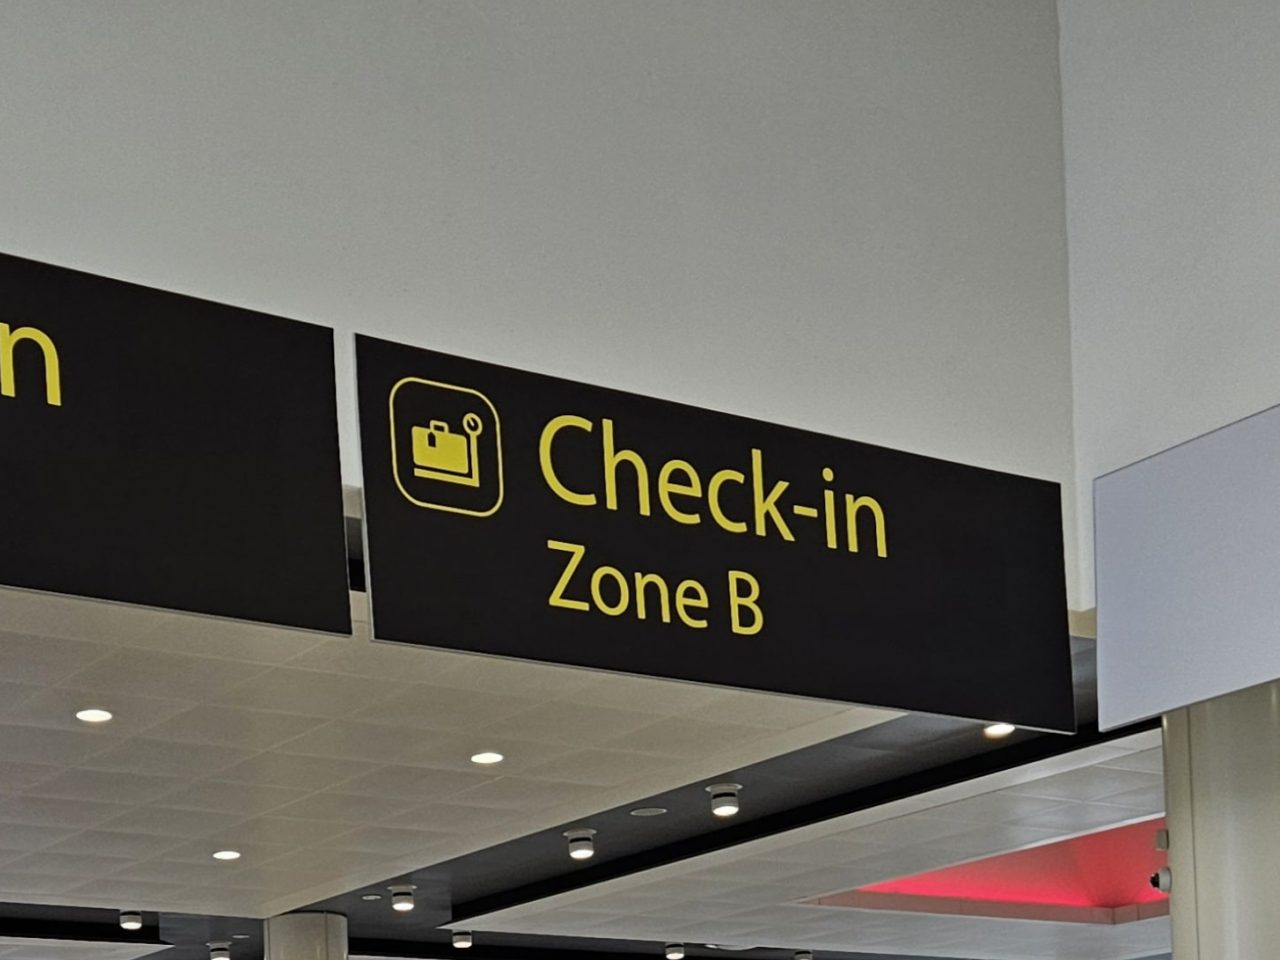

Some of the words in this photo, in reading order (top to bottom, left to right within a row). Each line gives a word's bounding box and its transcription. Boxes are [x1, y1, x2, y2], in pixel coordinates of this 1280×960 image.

[539, 415, 887, 558] Check-in
[547, 539, 710, 630] Zone
[728, 570, 764, 636] B
